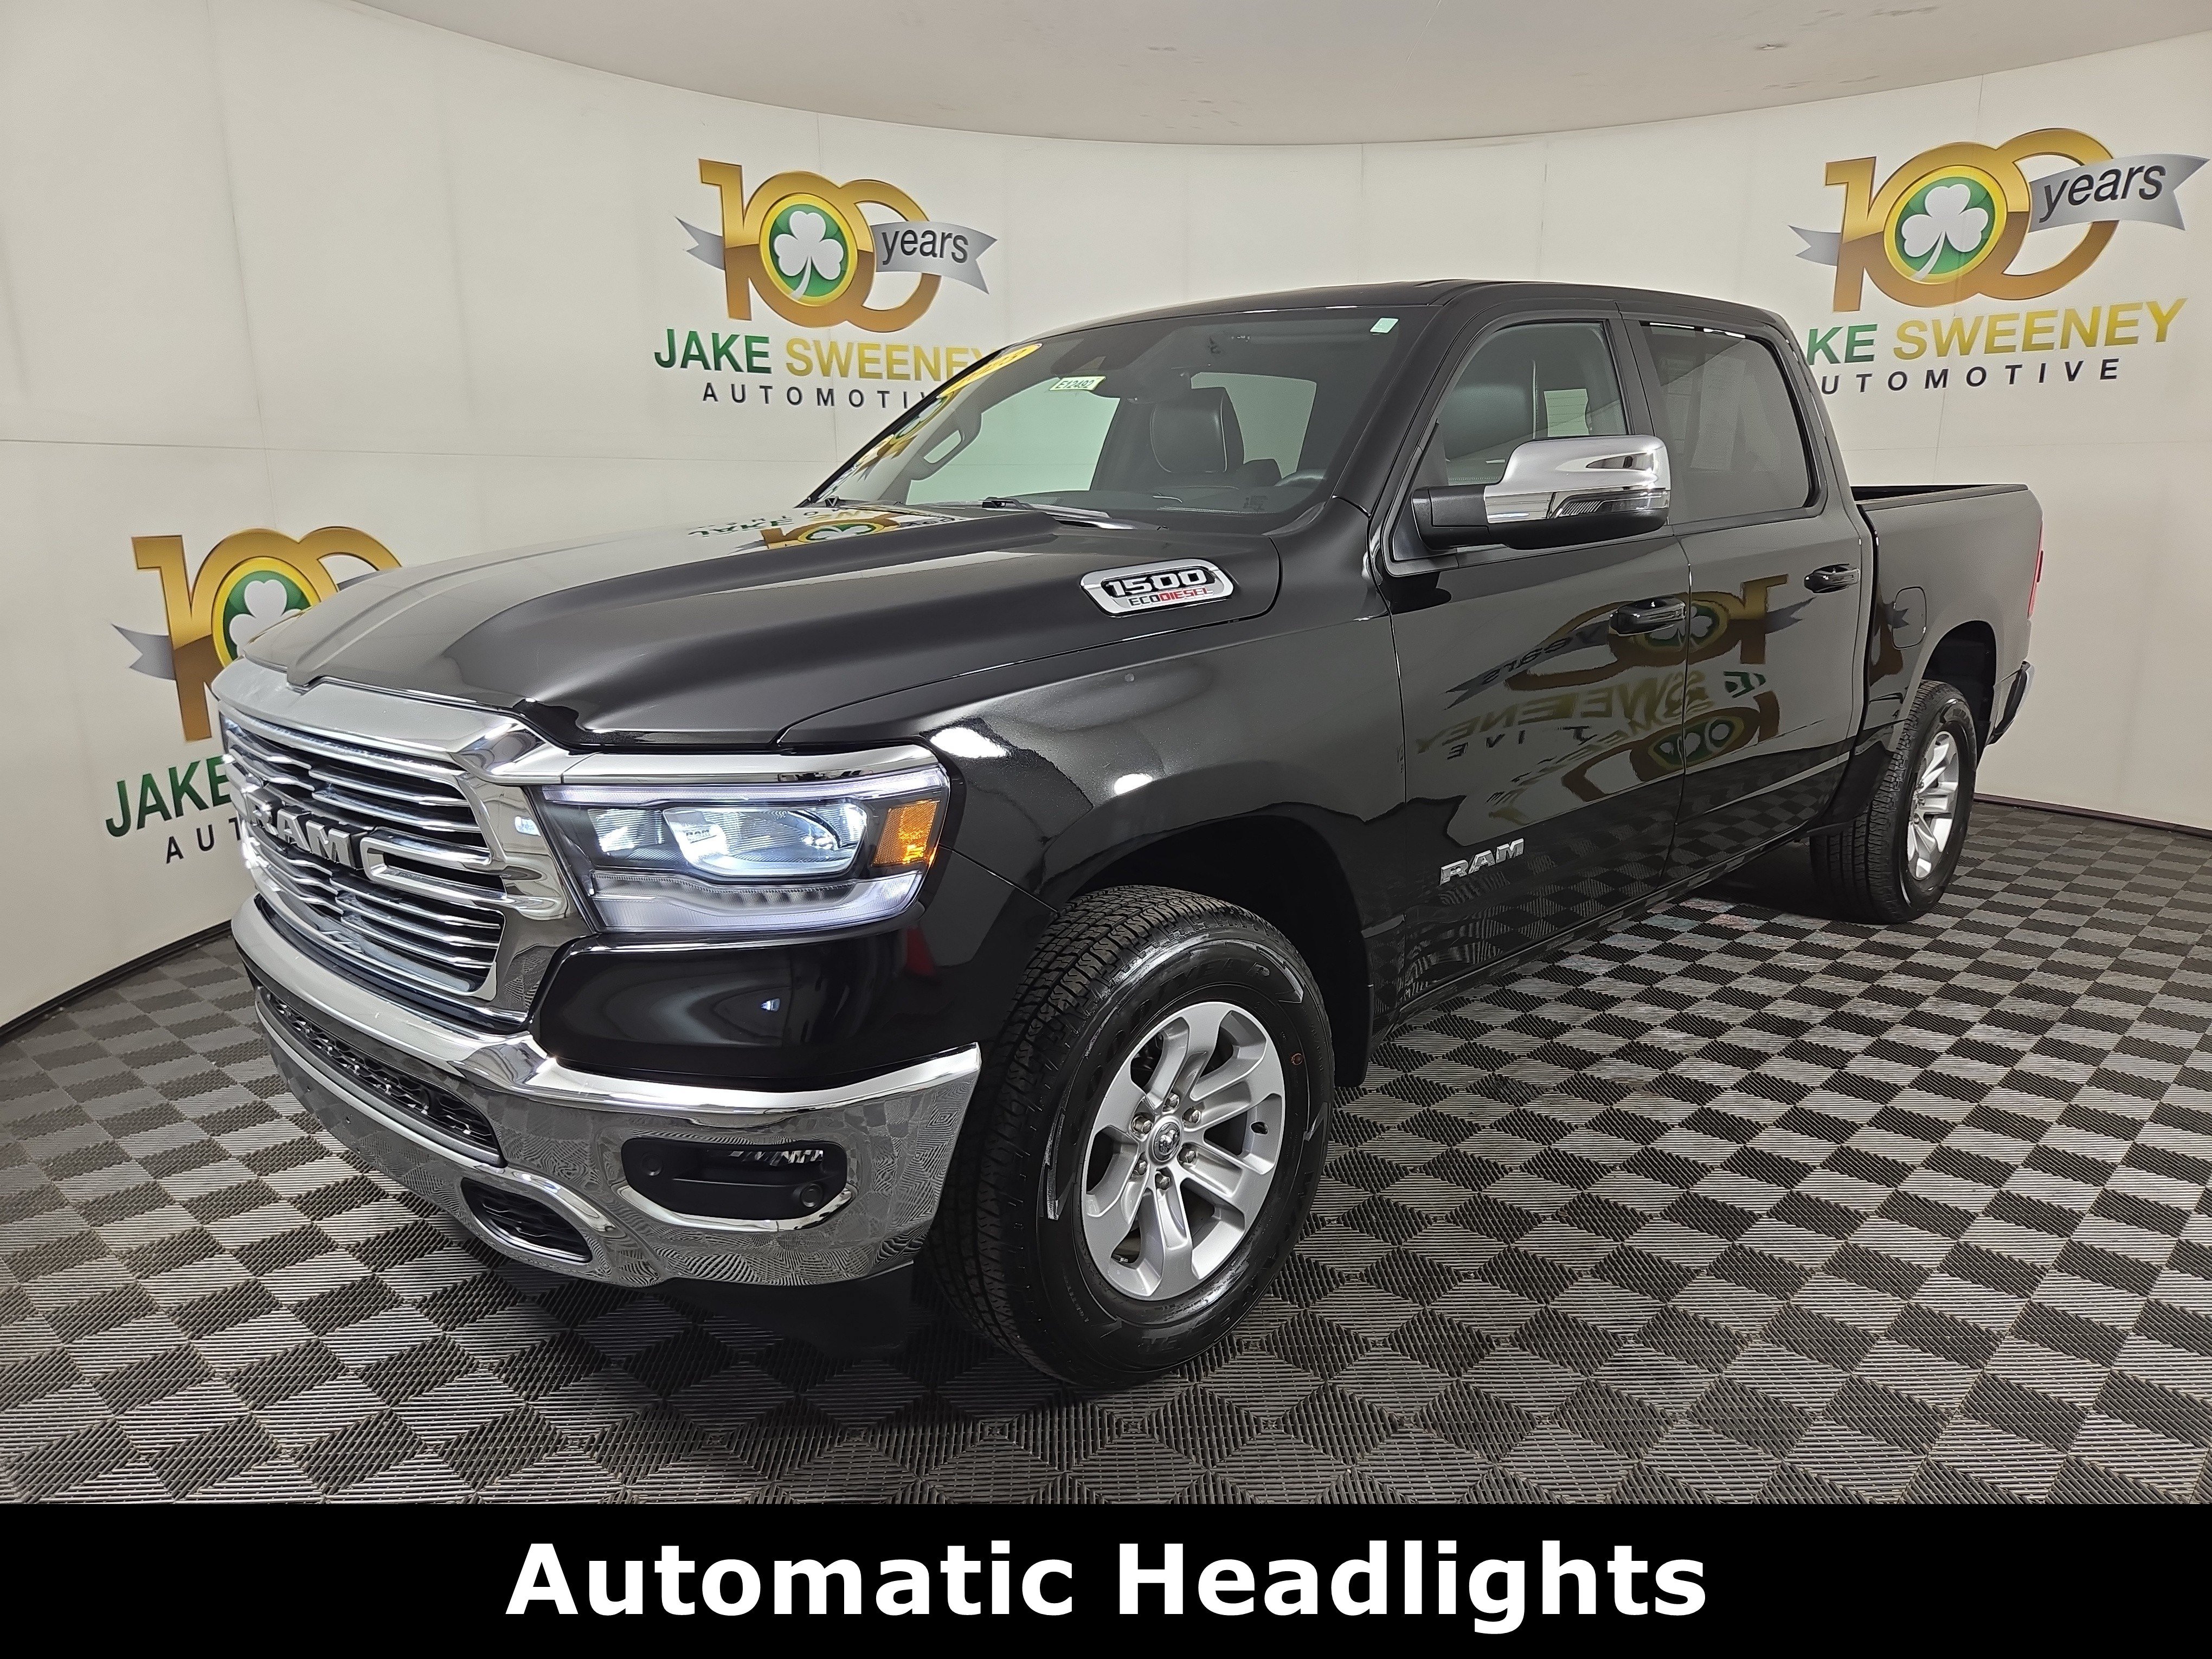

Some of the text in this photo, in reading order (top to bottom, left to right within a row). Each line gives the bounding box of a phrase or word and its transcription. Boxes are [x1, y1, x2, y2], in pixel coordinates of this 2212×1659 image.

[1825, 127, 2166, 313] 100 years
[698, 158, 969, 333] 100 years
[654, 329, 773, 375] JAKE
[1806, 297, 2189, 365] KE SWEENEY
[703, 382, 925, 409] AUTOMOTI
[1055, 380, 1095, 389] E12492
[1822, 358, 2120, 395] UTOMOTIVE
[1106, 569, 1208, 597] 1500
[1128, 586, 1213, 607] ECODIESEL
[105, 755, 232, 838] JAKE
[245, 789, 361, 871] RAM
[1439, 838, 1524, 886] RAM
